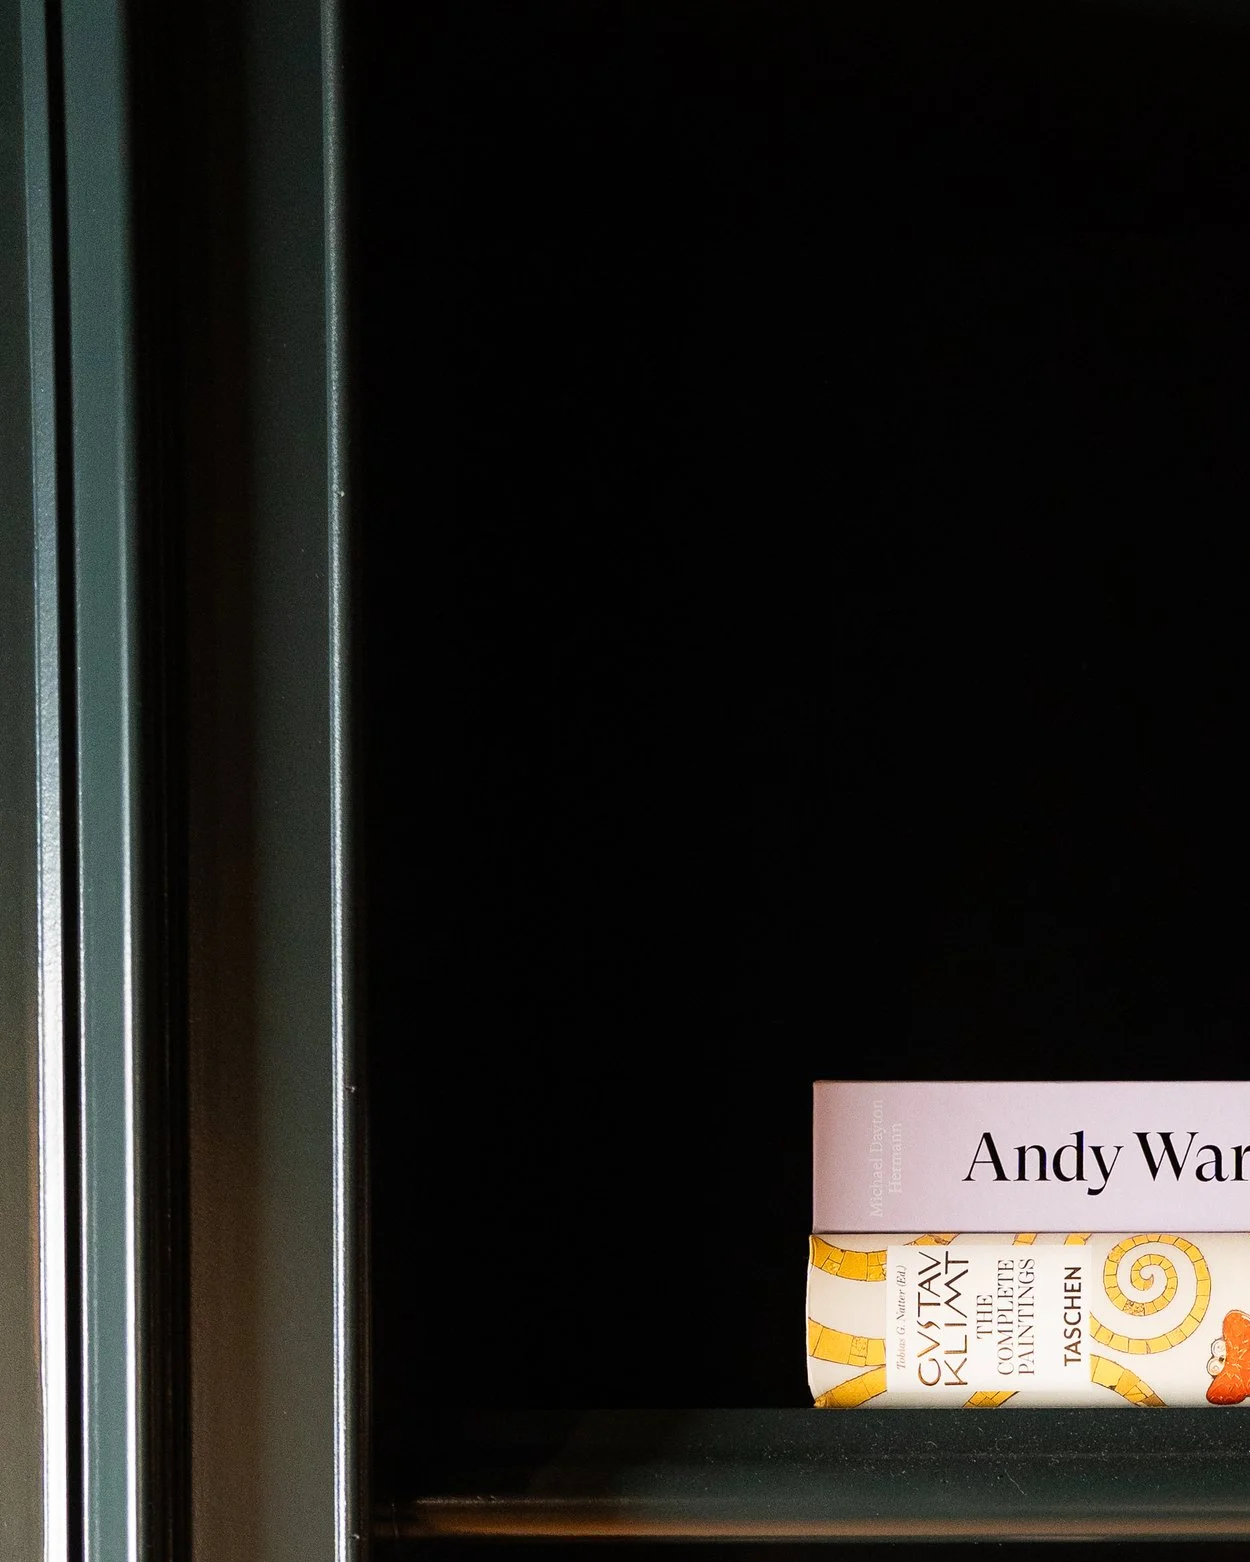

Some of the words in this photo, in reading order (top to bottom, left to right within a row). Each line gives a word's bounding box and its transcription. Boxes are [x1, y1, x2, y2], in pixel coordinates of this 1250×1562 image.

[869, 1099, 886, 1153] Dayton
[888, 1122, 902, 1194] Hermann
[869, 1158, 883, 1218] Michael
[962, 1130, 1124, 1196] Andy
[895, 1290, 906, 1322] Natter
[943, 1251, 969, 1386] KLIMT
[976, 1295, 993, 1339] THE
[997, 1259, 1015, 1376] COMPLETE
[1017, 1258, 1035, 1376] PAINTINGS
[1063, 1266, 1082, 1367] TASCHEN
[895, 1338, 906, 1370] Tobias
